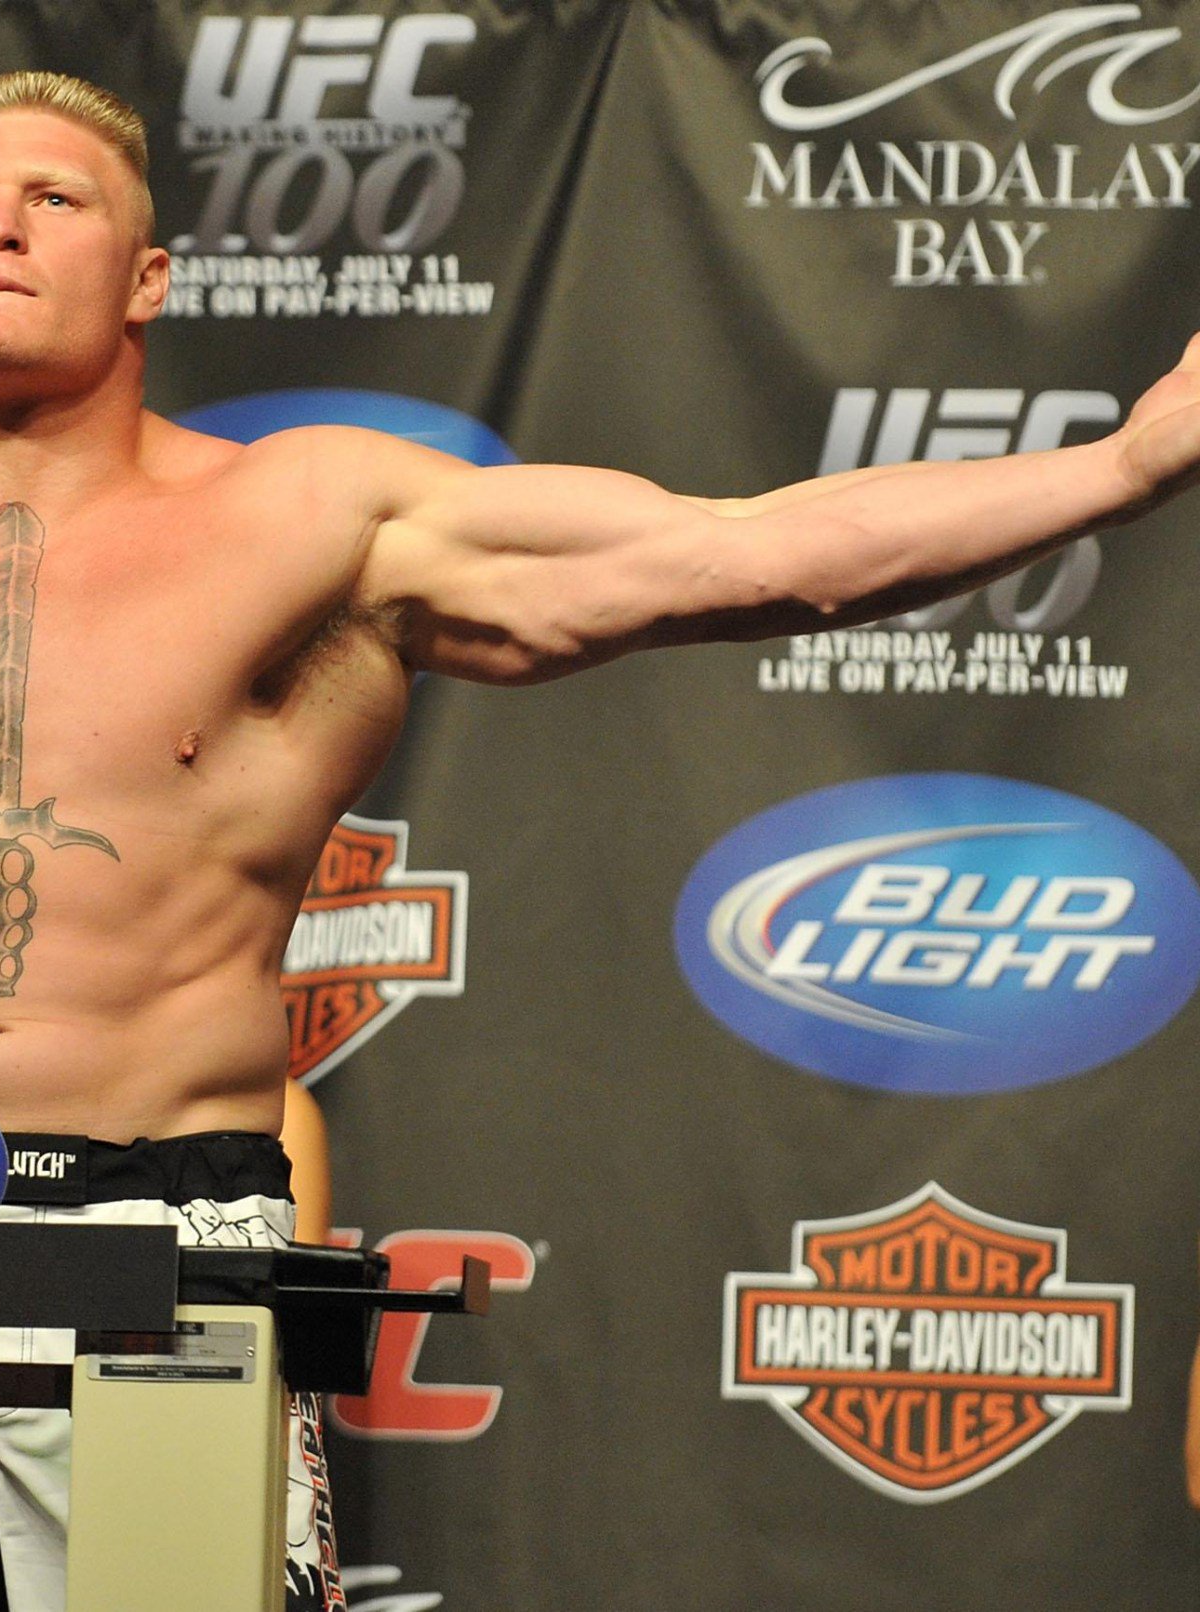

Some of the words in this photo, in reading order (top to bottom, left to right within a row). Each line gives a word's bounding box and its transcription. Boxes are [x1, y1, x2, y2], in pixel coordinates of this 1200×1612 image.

[181, 13, 477, 121] UFC
[170, 143, 466, 253] 100
[743, 138, 1200, 209] MANDALAY
[335, 253, 412, 285] JULY
[422, 253, 460, 284] 11
[890, 217, 1050, 287] BAY
[210, 284, 257, 318] ON
[263, 282, 495, 318] PAY-PER-VIEW
[757, 658, 830, 694] LIVE
[839, 661, 886, 694] ON
[894, 660, 1130, 698] PAY-PER-VIEW
[966, 632, 1044, 666] JULY
[1055, 635, 1092, 666] 11
[834, 863, 1137, 931] BUD
[764, 919, 1157, 991] LIGHT
[837, 1220, 1021, 1296] MOTOR
[755, 1302, 1100, 1378] HARLEY-DAVIDSON
[831, 1386, 1017, 1470] CYCLES
